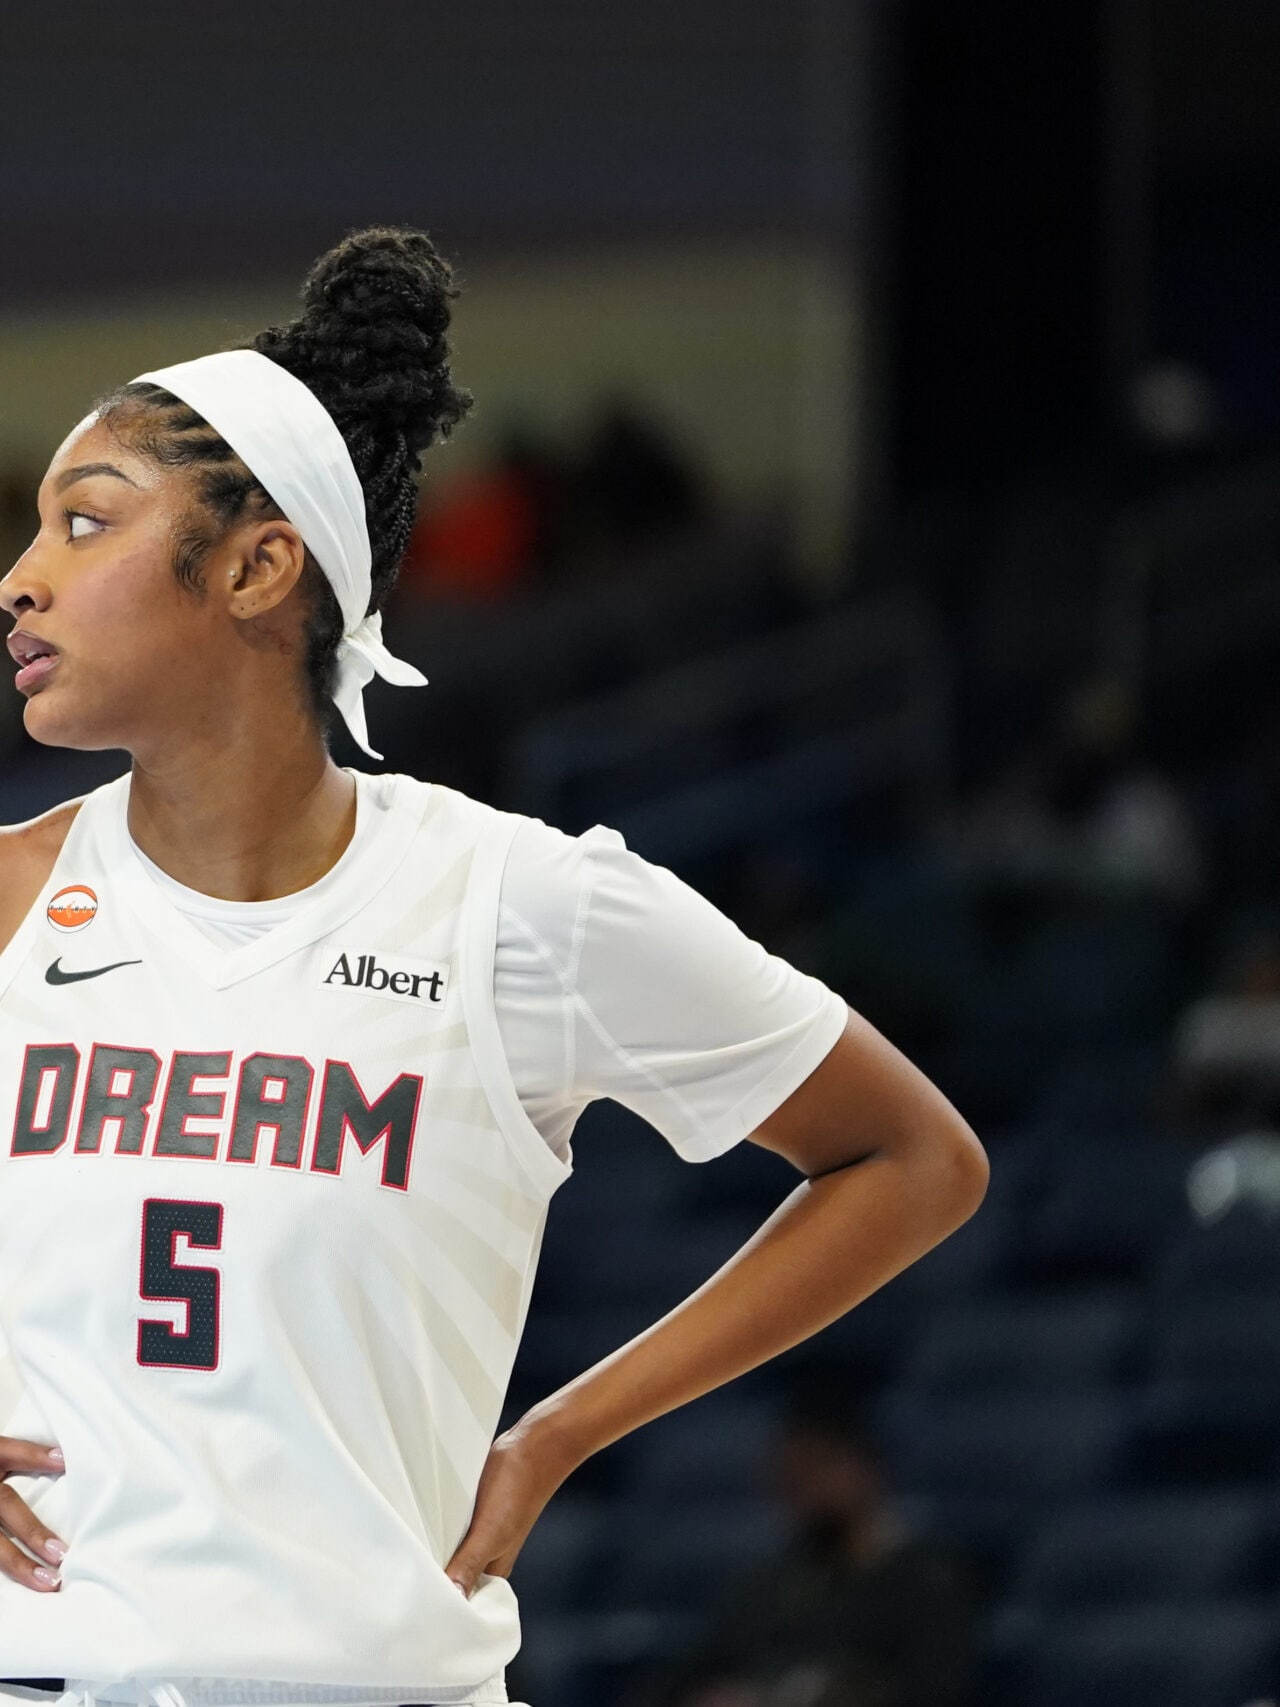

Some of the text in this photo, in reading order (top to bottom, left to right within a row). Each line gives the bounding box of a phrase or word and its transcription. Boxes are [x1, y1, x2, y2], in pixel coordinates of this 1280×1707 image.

[323, 953, 444, 1002] Albert
[10, 1042, 424, 1191] DREAM
[137, 1198, 224, 1370] 5
